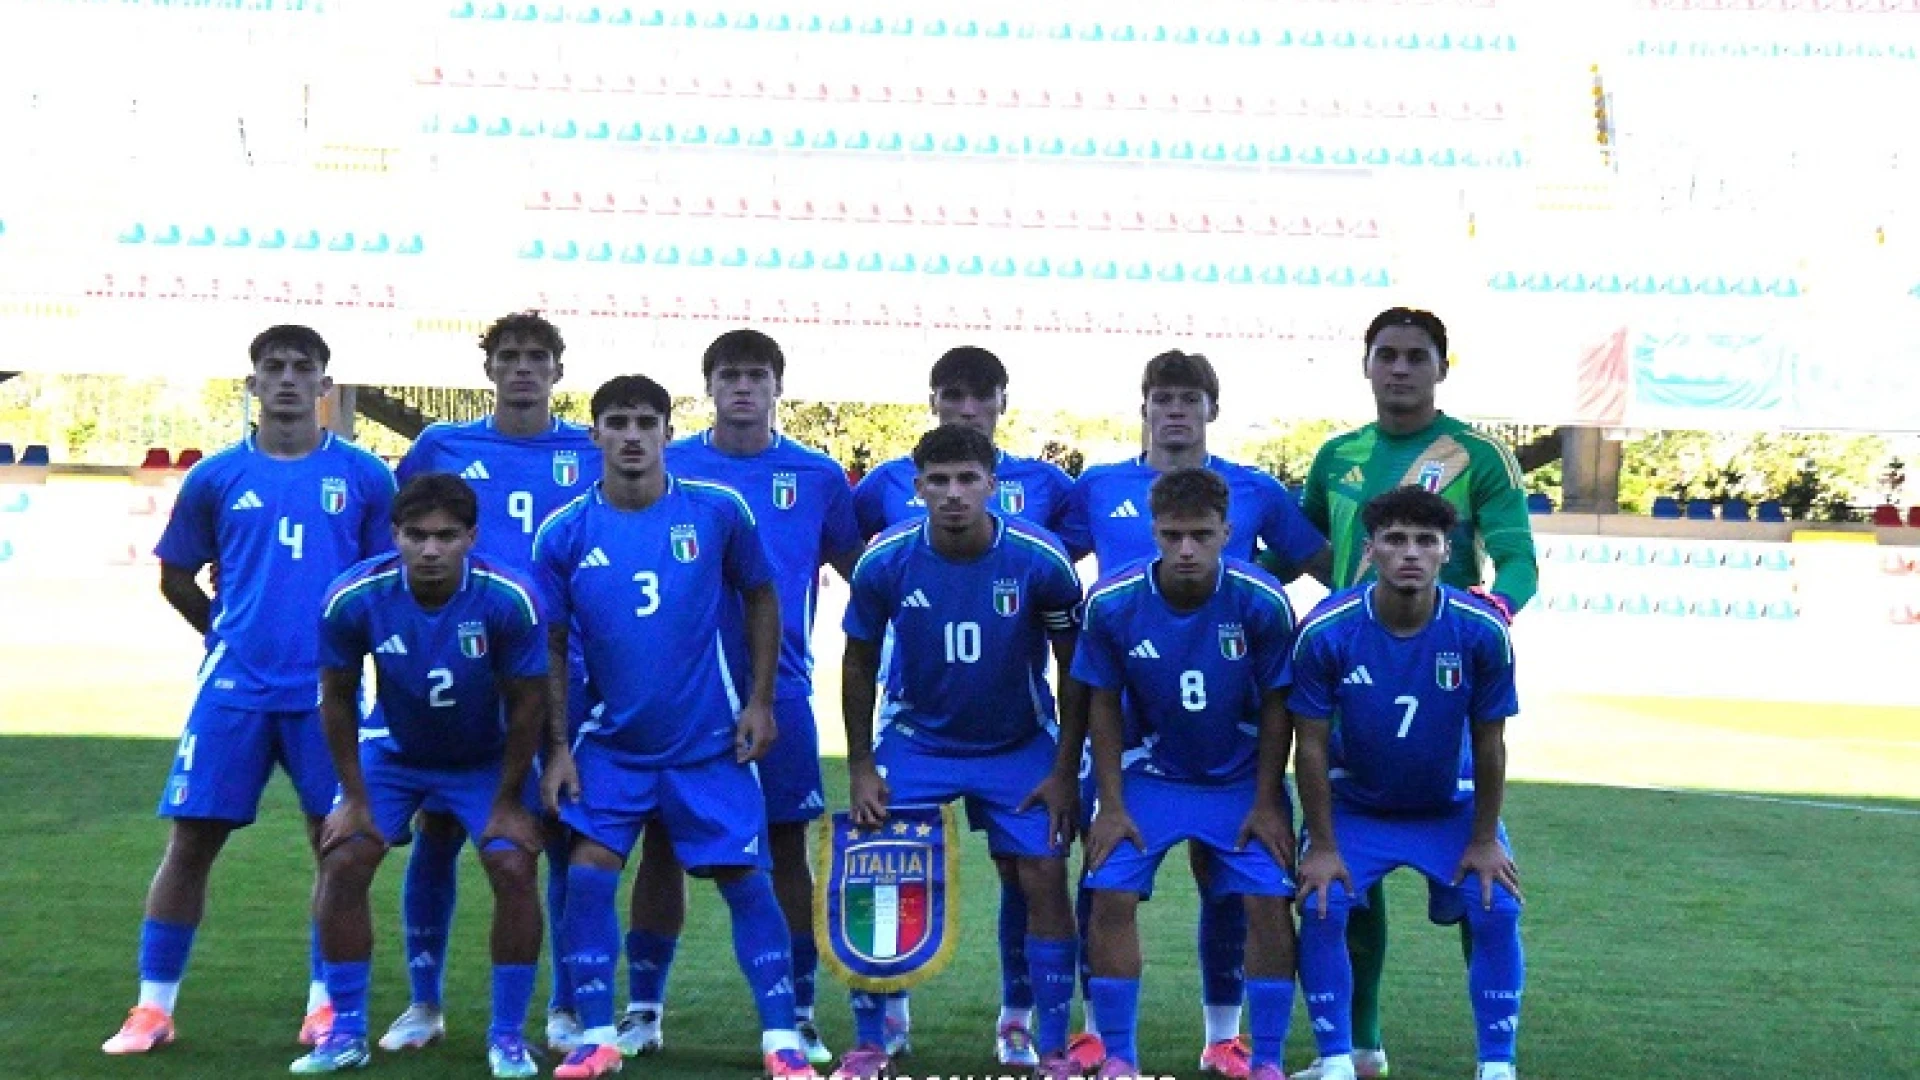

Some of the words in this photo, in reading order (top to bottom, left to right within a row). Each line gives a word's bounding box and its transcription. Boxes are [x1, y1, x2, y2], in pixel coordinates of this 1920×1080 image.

[508, 491, 533, 533] 9
[278, 516, 303, 559] 4
[634, 570, 660, 617] 3
[944, 621, 981, 663] 10
[428, 667, 456, 707] 2
[1179, 670, 1206, 710] 8
[1394, 695, 1419, 738] 7
[178, 730, 198, 771] 4
[849, 852, 925, 876] ITALIA
